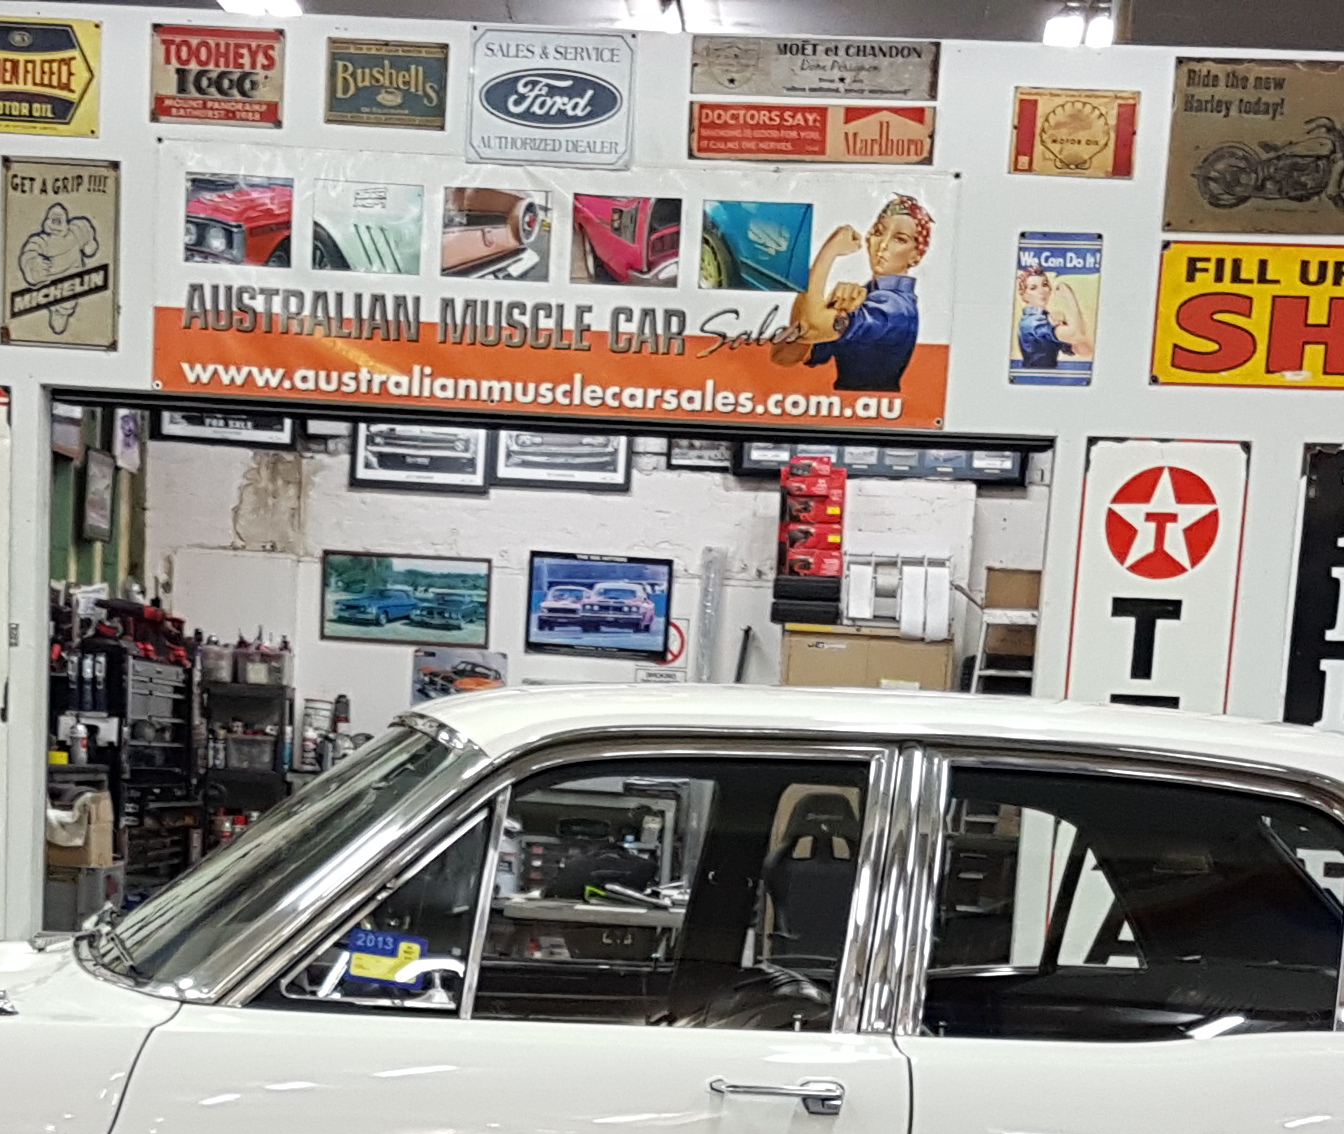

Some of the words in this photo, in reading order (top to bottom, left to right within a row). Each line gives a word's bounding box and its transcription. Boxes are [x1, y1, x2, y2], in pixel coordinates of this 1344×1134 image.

[160, 39, 276, 71] TOOHEYS
[484, 42, 535, 59] SALES
[539, 45, 550, 60] &
[553, 44, 621, 63] SERVICE
[824, 44, 841, 57] et
[845, 44, 924, 59] CHANDON
[23, 56, 77, 94] FLEECE
[175, 67, 261, 98] 1000
[335, 59, 438, 107] Bushells
[1186, 69, 1220, 89] Ride
[1224, 70, 1249, 90] the
[1252, 75, 1287, 90] new
[31, 102, 55, 118] OIL
[507, 76, 595, 117] Ford
[1184, 93, 1231, 119] Harley
[1238, 97, 1285, 121] today!
[700, 108, 781, 125] DOCTORS
[783, 110, 821, 127] SAY:
[478, 135, 563, 152] AUTHORIZED
[565, 139, 620, 155] DEALER
[843, 119, 925, 157] Marlboro
[10, 173, 37, 194] GET
[39, 177, 48, 195] A
[52, 174, 84, 195] GRIP
[1019, 251, 1039, 267] We
[1040, 251, 1065, 268] Can
[1065, 252, 1084, 268] Do
[1085, 252, 1101, 268] It!
[1185, 256, 1281, 286] FILL
[13, 269, 105, 313] MICHELIN
[182, 283, 420, 343] AUSTRALIAN
[438, 297, 594, 352] MUSCLE
[608, 305, 686, 356] CAR
[696, 304, 804, 359] Sales
[180, 361, 904, 420] www.australianmusclecarsales.com.au
[204, 417, 225, 428] FOR
[1144, 511, 1179, 553] T
[1110, 596, 1183, 709] T
[355, 933, 394, 950] 2013
